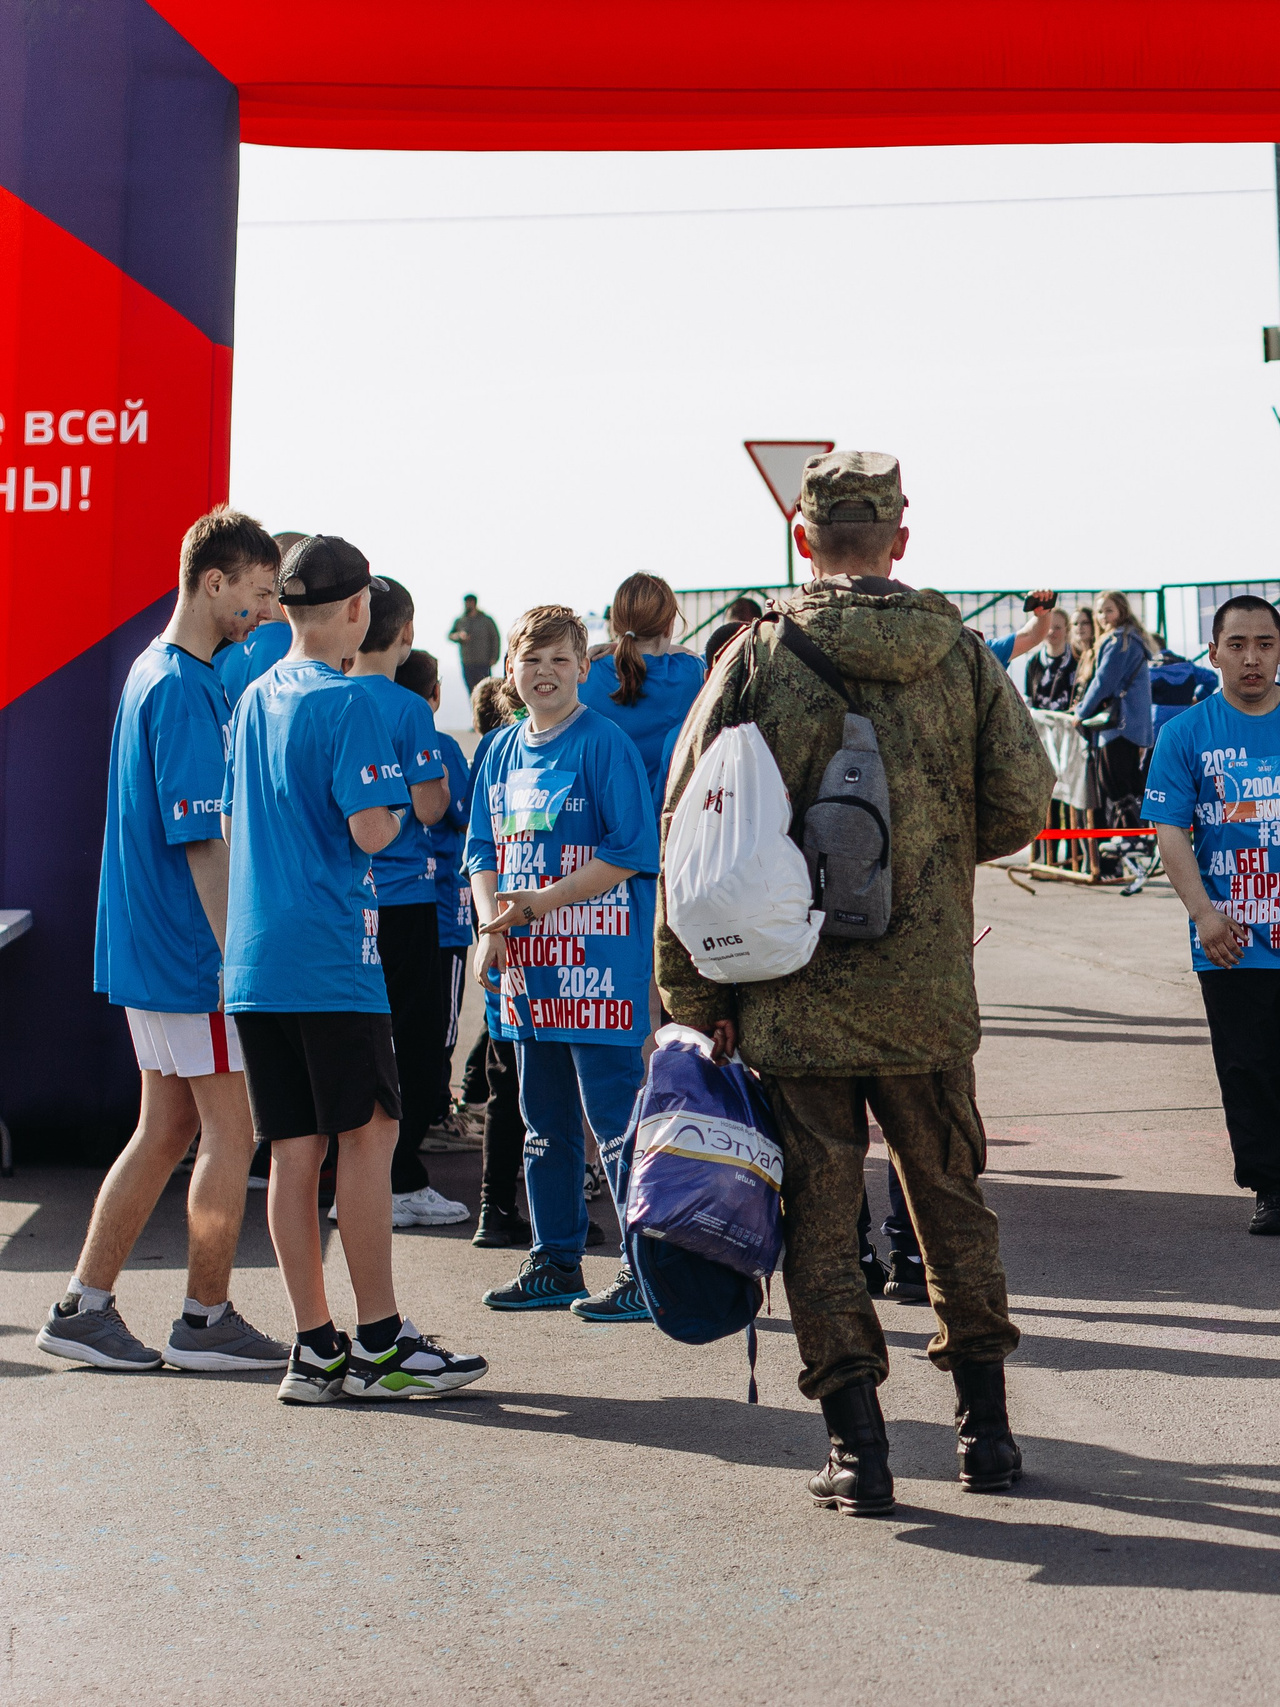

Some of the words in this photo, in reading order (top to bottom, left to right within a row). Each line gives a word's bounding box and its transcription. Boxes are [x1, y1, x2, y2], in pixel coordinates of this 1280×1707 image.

[24, 399, 149, 446] всей
[380, 763, 403, 779] ПС
[561, 797, 586, 812] БЕГ
[505, 843, 546, 874] 2024
[1208, 847, 1269, 876] #ЗАБЕГ
[716, 934, 743, 948] ПСБ
[557, 966, 615, 998] 2024
[734, 1170, 756, 1187] letu.ru
[643, 1278, 660, 1308] VOYAGER
